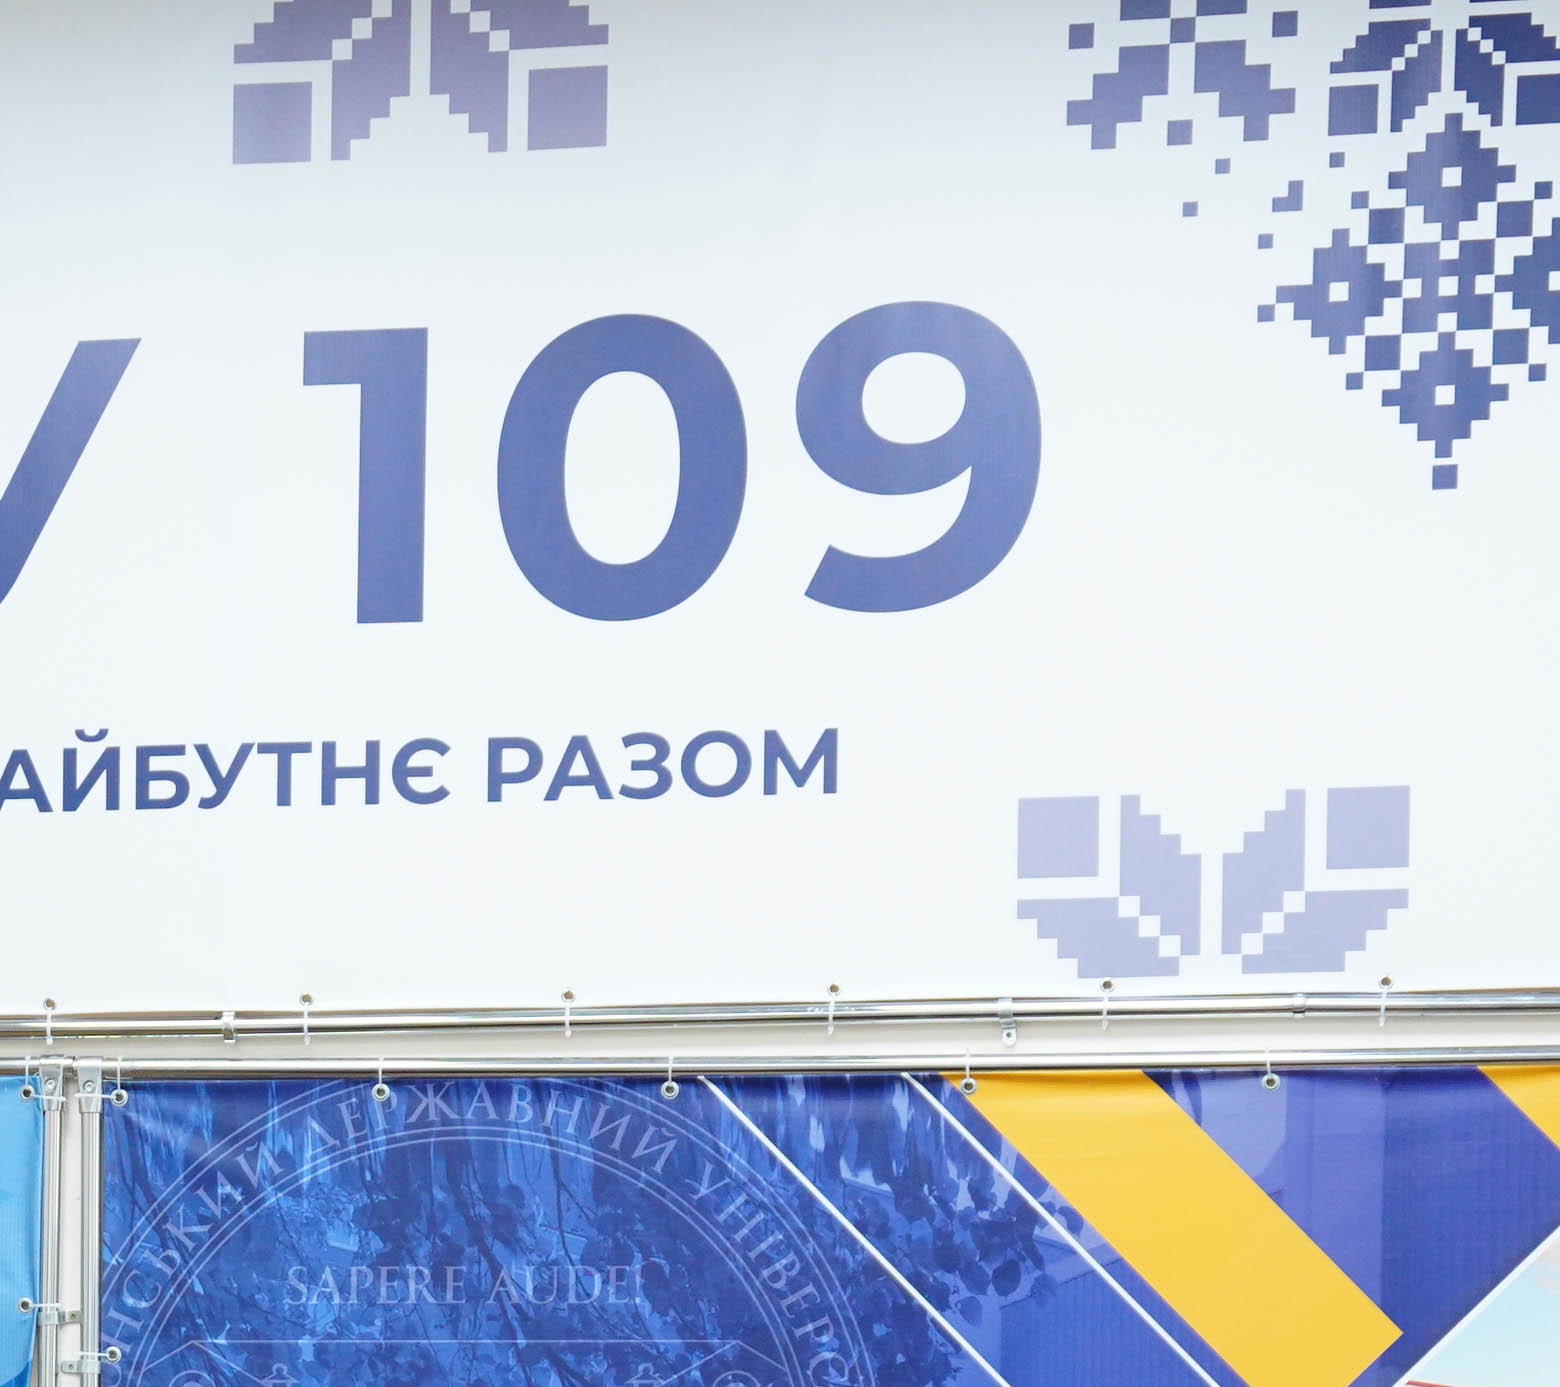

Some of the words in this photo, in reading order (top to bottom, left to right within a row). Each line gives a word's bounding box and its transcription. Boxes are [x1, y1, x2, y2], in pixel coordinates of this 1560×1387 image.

[302, 300, 1042, 625] 109
[486, 727, 838, 802] РАЗОМ
[282, 1264, 468, 1306] SAPERE
[487, 1263, 643, 1306] AUDE!
